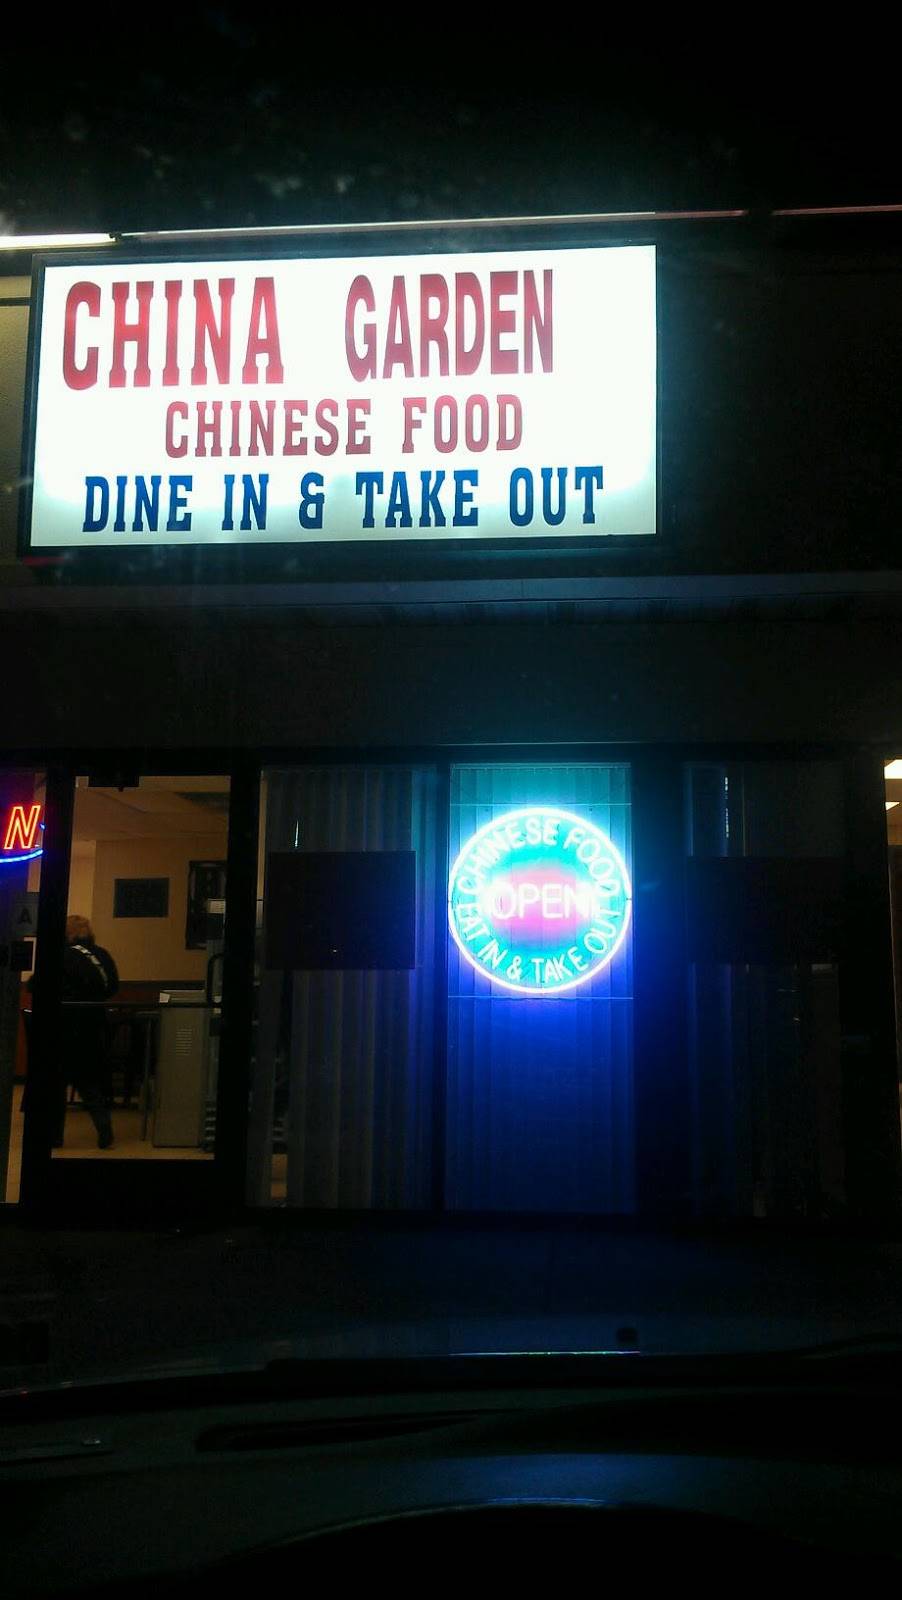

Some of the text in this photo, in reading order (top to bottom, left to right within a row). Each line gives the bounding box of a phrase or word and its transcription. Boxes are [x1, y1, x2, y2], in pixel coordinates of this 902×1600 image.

[62, 269, 554, 390] CHINA GARDEN
[165, 394, 523, 458] CHINESE FOOD
[83, 465, 604, 533] DINE IN & TAKE OUT
[457, 817, 621, 896] CHINESE FOOD
[492, 882, 591, 919] OPEN
[457, 903, 621, 984] EAT IN & TAKE OUT
